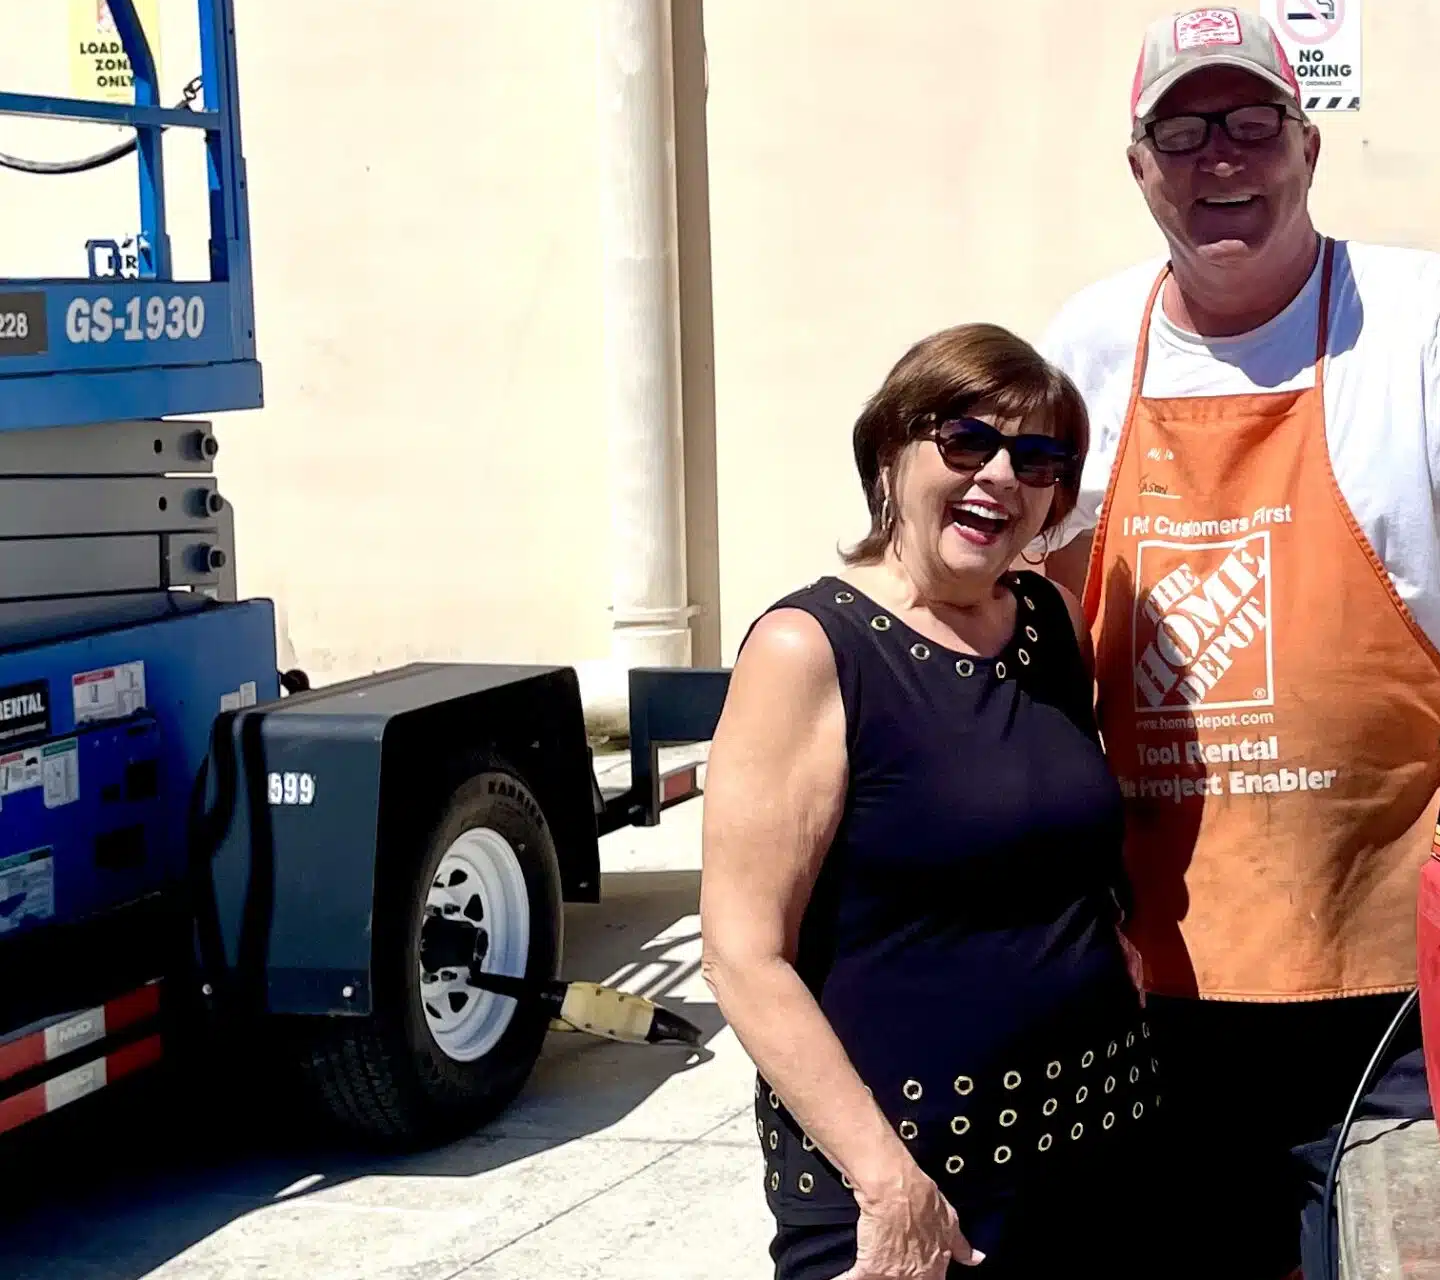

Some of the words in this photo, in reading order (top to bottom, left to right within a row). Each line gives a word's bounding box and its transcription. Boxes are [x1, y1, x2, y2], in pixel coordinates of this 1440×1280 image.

[79, 42, 127, 55] LOAD
[1299, 50, 1324, 62] NO
[95, 59, 136, 71] ZON
[1297, 64, 1352, 77] OKING
[97, 75, 137, 87] ONLY
[66, 295, 205, 343] GS-1930
[1123, 517, 1128, 536] I
[1142, 563, 1200, 620] THE
[1136, 542, 1268, 707] HOME
[1177, 598, 1267, 707] DEPOT
[1136, 742, 1180, 767] Tool
[1185, 735, 1279, 765] Rental
[1140, 772, 1224, 804] Project
[1229, 767, 1337, 795] Enabler
